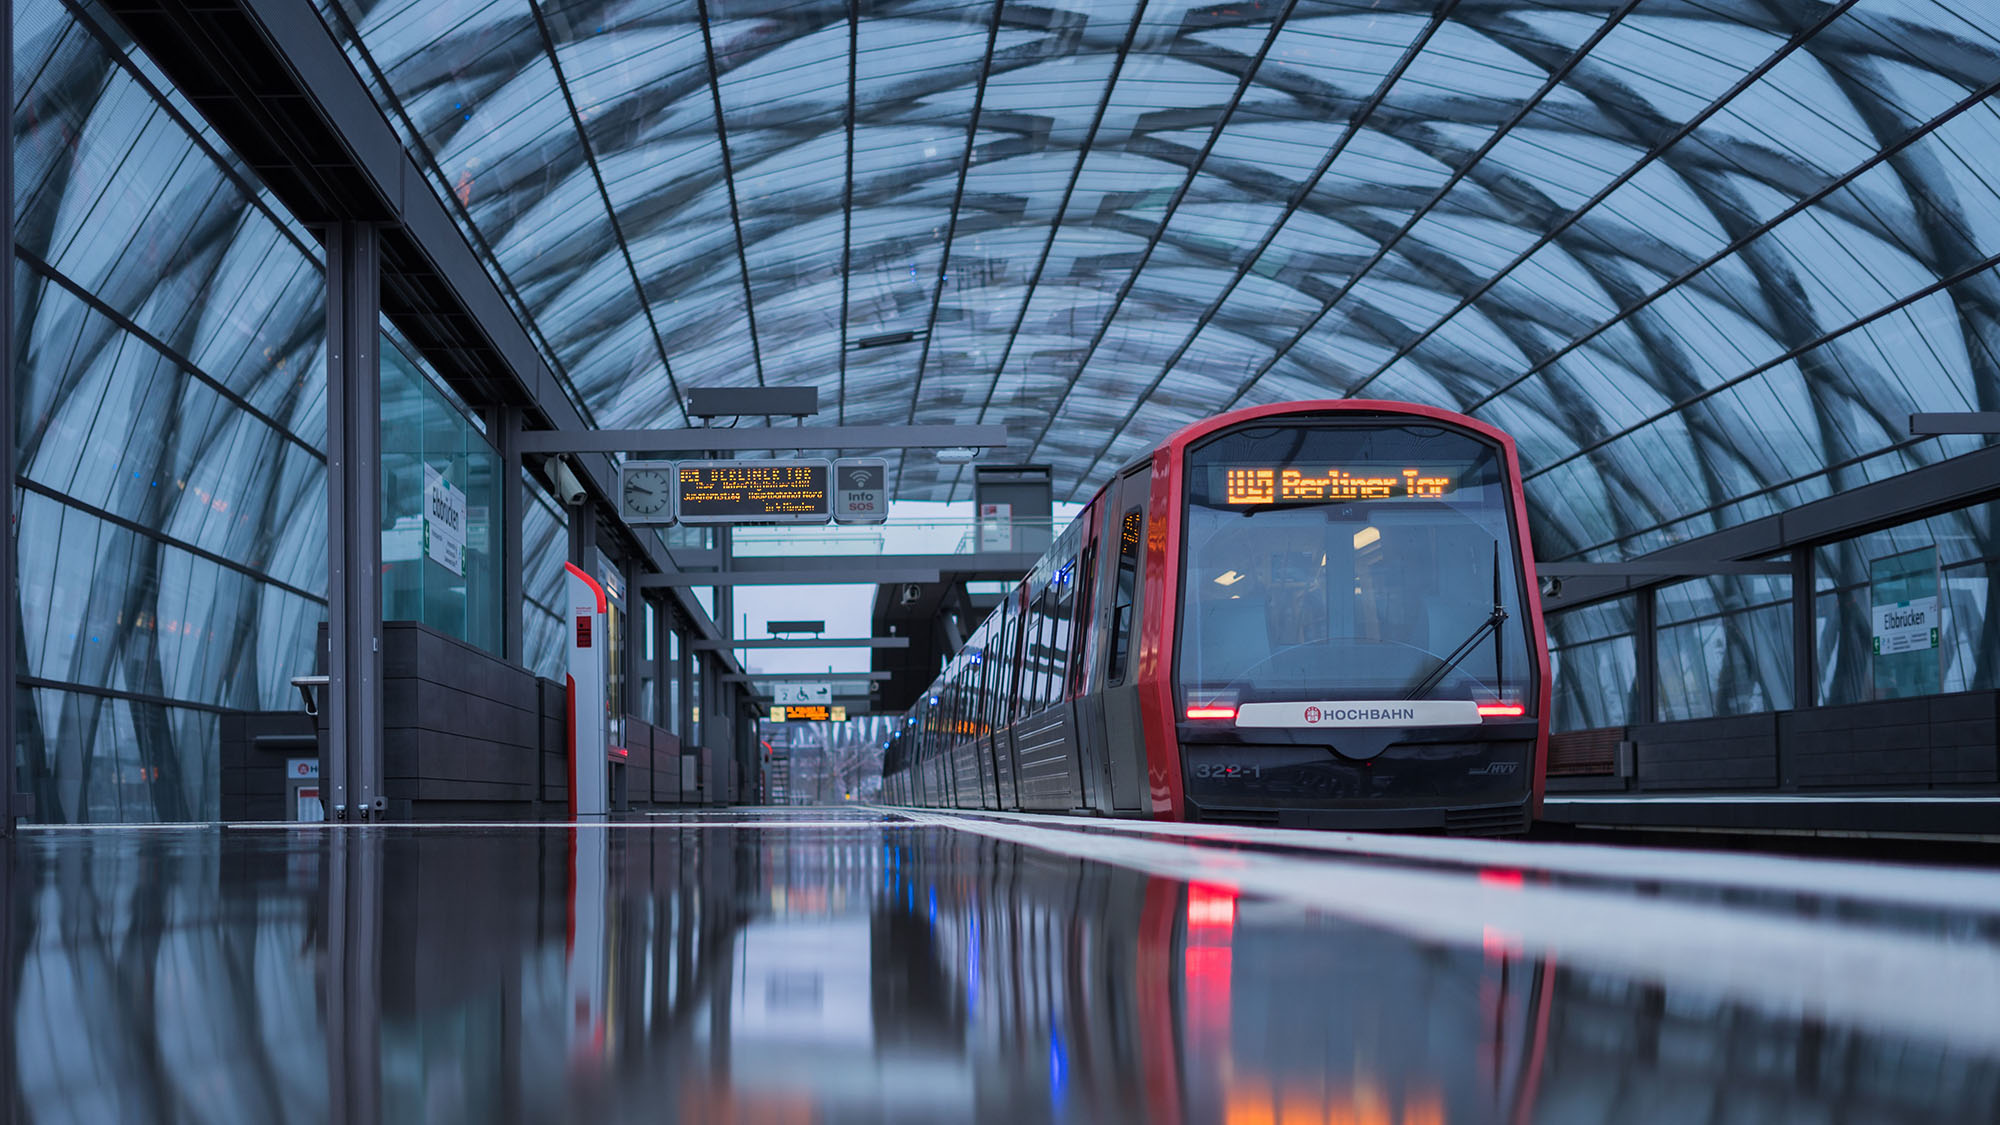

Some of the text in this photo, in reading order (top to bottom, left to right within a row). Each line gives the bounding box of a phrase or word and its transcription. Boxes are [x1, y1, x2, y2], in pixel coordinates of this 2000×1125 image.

[711, 467, 780, 482] BERLINER
[786, 467, 812, 481] TOR
[1282, 469, 1398, 499] Berliner
[1402, 468, 1449, 498] Tor
[848, 492, 873, 501] Info
[849, 502, 874, 511] SOS
[1884, 608, 1925, 630] Elbbrücken
[1323, 708, 1414, 721] HOCHBAHN
[1196, 763, 1261, 778] 322-1
